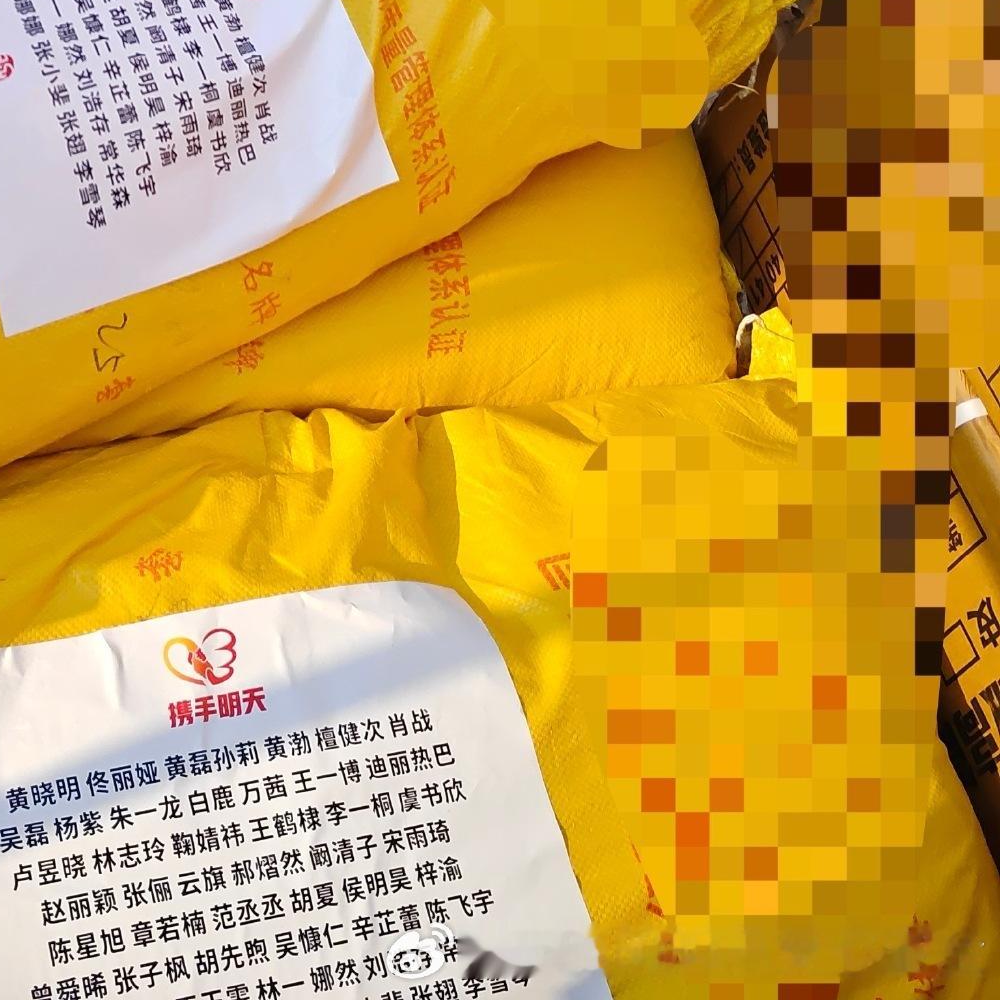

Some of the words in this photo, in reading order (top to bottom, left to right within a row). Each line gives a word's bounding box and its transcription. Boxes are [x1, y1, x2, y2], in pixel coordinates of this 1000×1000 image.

[30, 39, 71, 107] 张小斐
[55, 109, 87, 158] 张翅
[72, 159, 107, 229] 李雪琴
[54, 21, 87, 66] 娜然
[72, 68, 111, 136] 刘浩存
[97, 139, 131, 210] 常华森
[102, 59, 139, 125] 辛芷蕾
[123, 128, 157, 197] 陈飞宇
[108, 5, 141, 49] 胡夏
[127, 52, 166, 118] 侯明昊
[151, 120, 178, 168] 梓渝
[143, 24, 185, 87] 阚清子
[172, 90, 203, 158] 宋雨琦
[182, 39, 221, 105] 李一桐
[203, 107, 233, 176] 虞书欣
[196, 13, 239, 74] 王一博
[225, 76, 257, 166] 迪丽热巴
[234, 36, 268, 97] 檀健次
[253, 99, 278, 145] 肖战
[5, 776, 81, 813] 黄晓明
[86, 761, 161, 796] 佟丽娅
[164, 740, 260, 780] 黄磊孙莉
[264, 730, 312, 762] 黄渤
[315, 718, 384, 752] 檀健次
[388, 708, 433, 738] 肖战
[168, 686, 267, 729] 携手明天
[0, 820, 49, 853] 吴磊
[54, 811, 104, 842] 杨紫
[110, 795, 183, 830] 朱一龙
[188, 785, 236, 816] 白鹿
[239, 774, 288, 806] 万茜
[292, 759, 362, 794] 王一博
[365, 743, 455, 781] 迪丽热巴
[13, 853, 87, 891] 卢昱晓
[92, 837, 166, 875] 林志玲
[171, 822, 245, 859] 鞠婧祎
[248, 805, 322, 843] 王鹤棣
[325, 791, 395, 827] 李一桐
[399, 777, 467, 813] 虞书欣
[41, 887, 118, 927] 赵丽颖
[122, 876, 173, 909] 张俪
[177, 865, 226, 898] 云旗
[231, 849, 306, 887] 郝熠然
[309, 834, 377, 871] 阚清子
[382, 819, 451, 854] 宋雨琦
[47, 927, 126, 967] 陈星旭
[130, 910, 207, 948] 章若楠
[210, 893, 286, 931] 范丞丞
[290, 881, 339, 915] 胡夏
[342, 867, 412, 903] 侯明昊
[415, 856, 463, 888] 梓渝
[112, 955, 191, 995] 张子枫
[194, 938, 271, 976] 胡先煦
[274, 921, 348, 959] 吴慷仁
[352, 904, 422, 941] 辛芷蕾
[425, 889, 494, 925] 陈飞宇
[256, 976, 305, 1000] 林一
[310, 958, 360, 993] 娜然
